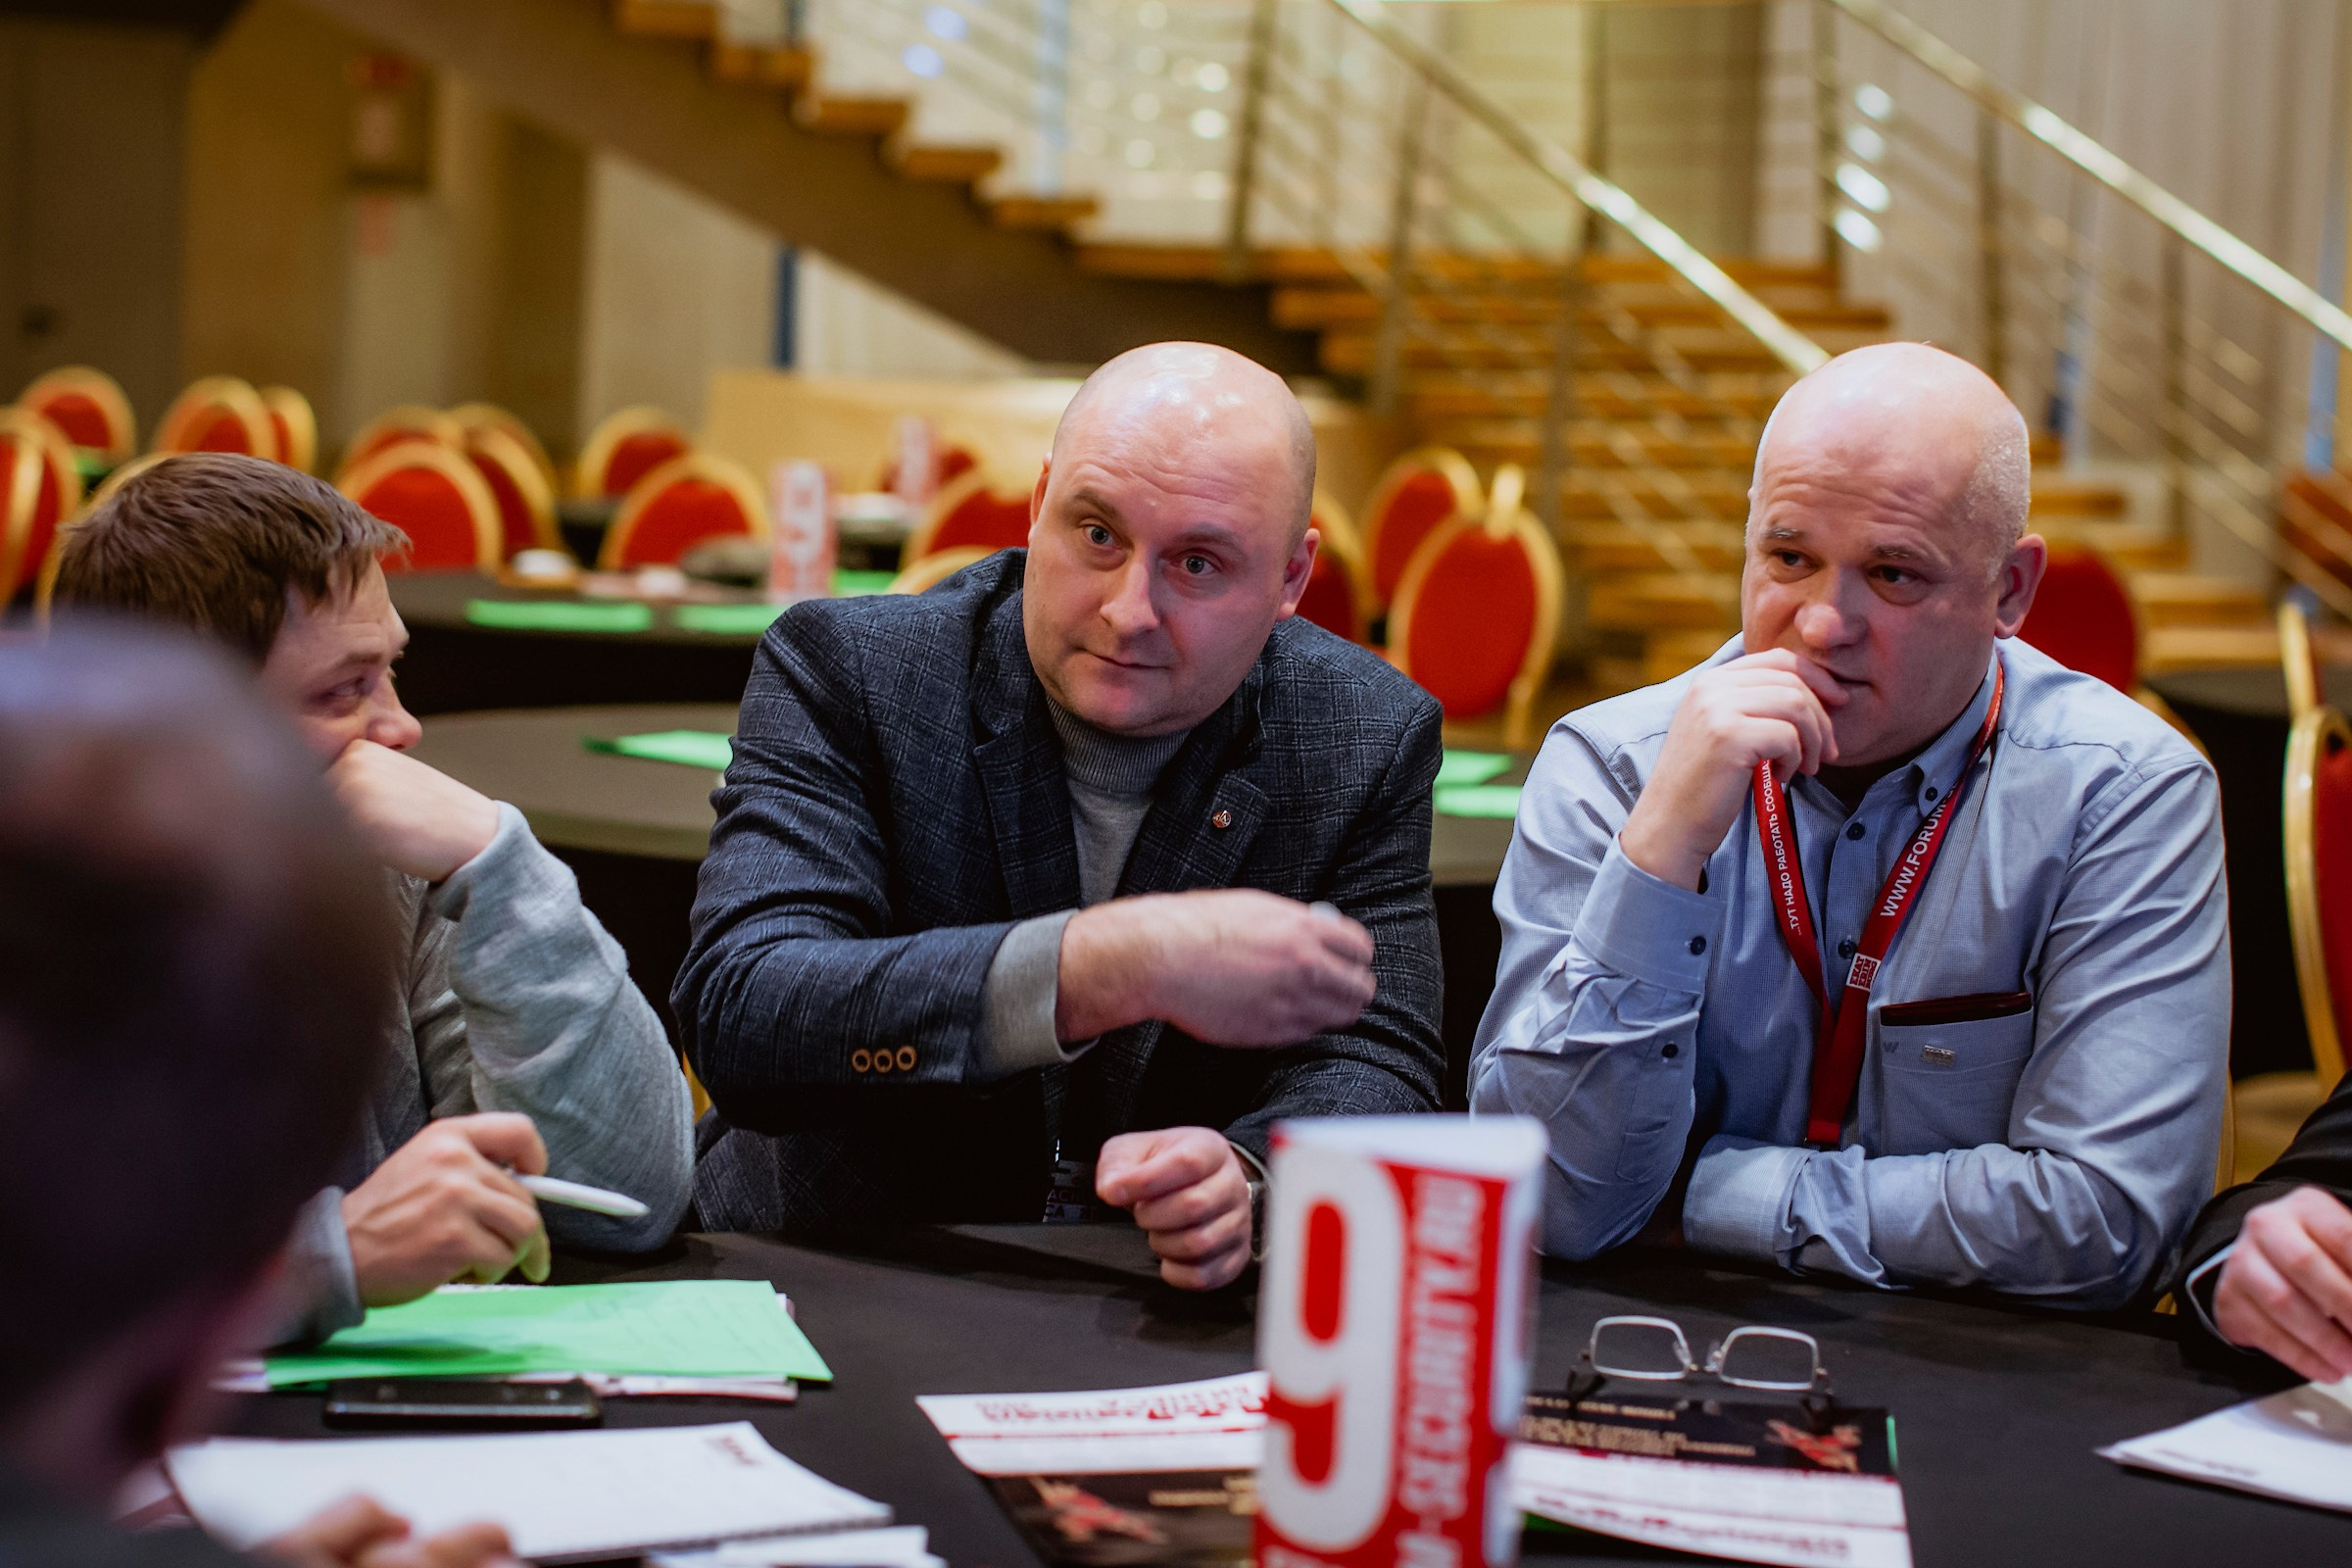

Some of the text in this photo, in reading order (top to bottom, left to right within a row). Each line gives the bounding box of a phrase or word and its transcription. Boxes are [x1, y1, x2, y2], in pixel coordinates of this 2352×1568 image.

[1769, 813, 1788, 870] РАБОТАТЬ
[1881, 791, 1953, 917] WWW.FORUM-
[1780, 872, 1794, 906] НАДО
[1258, 1145, 1405, 1553] 9
